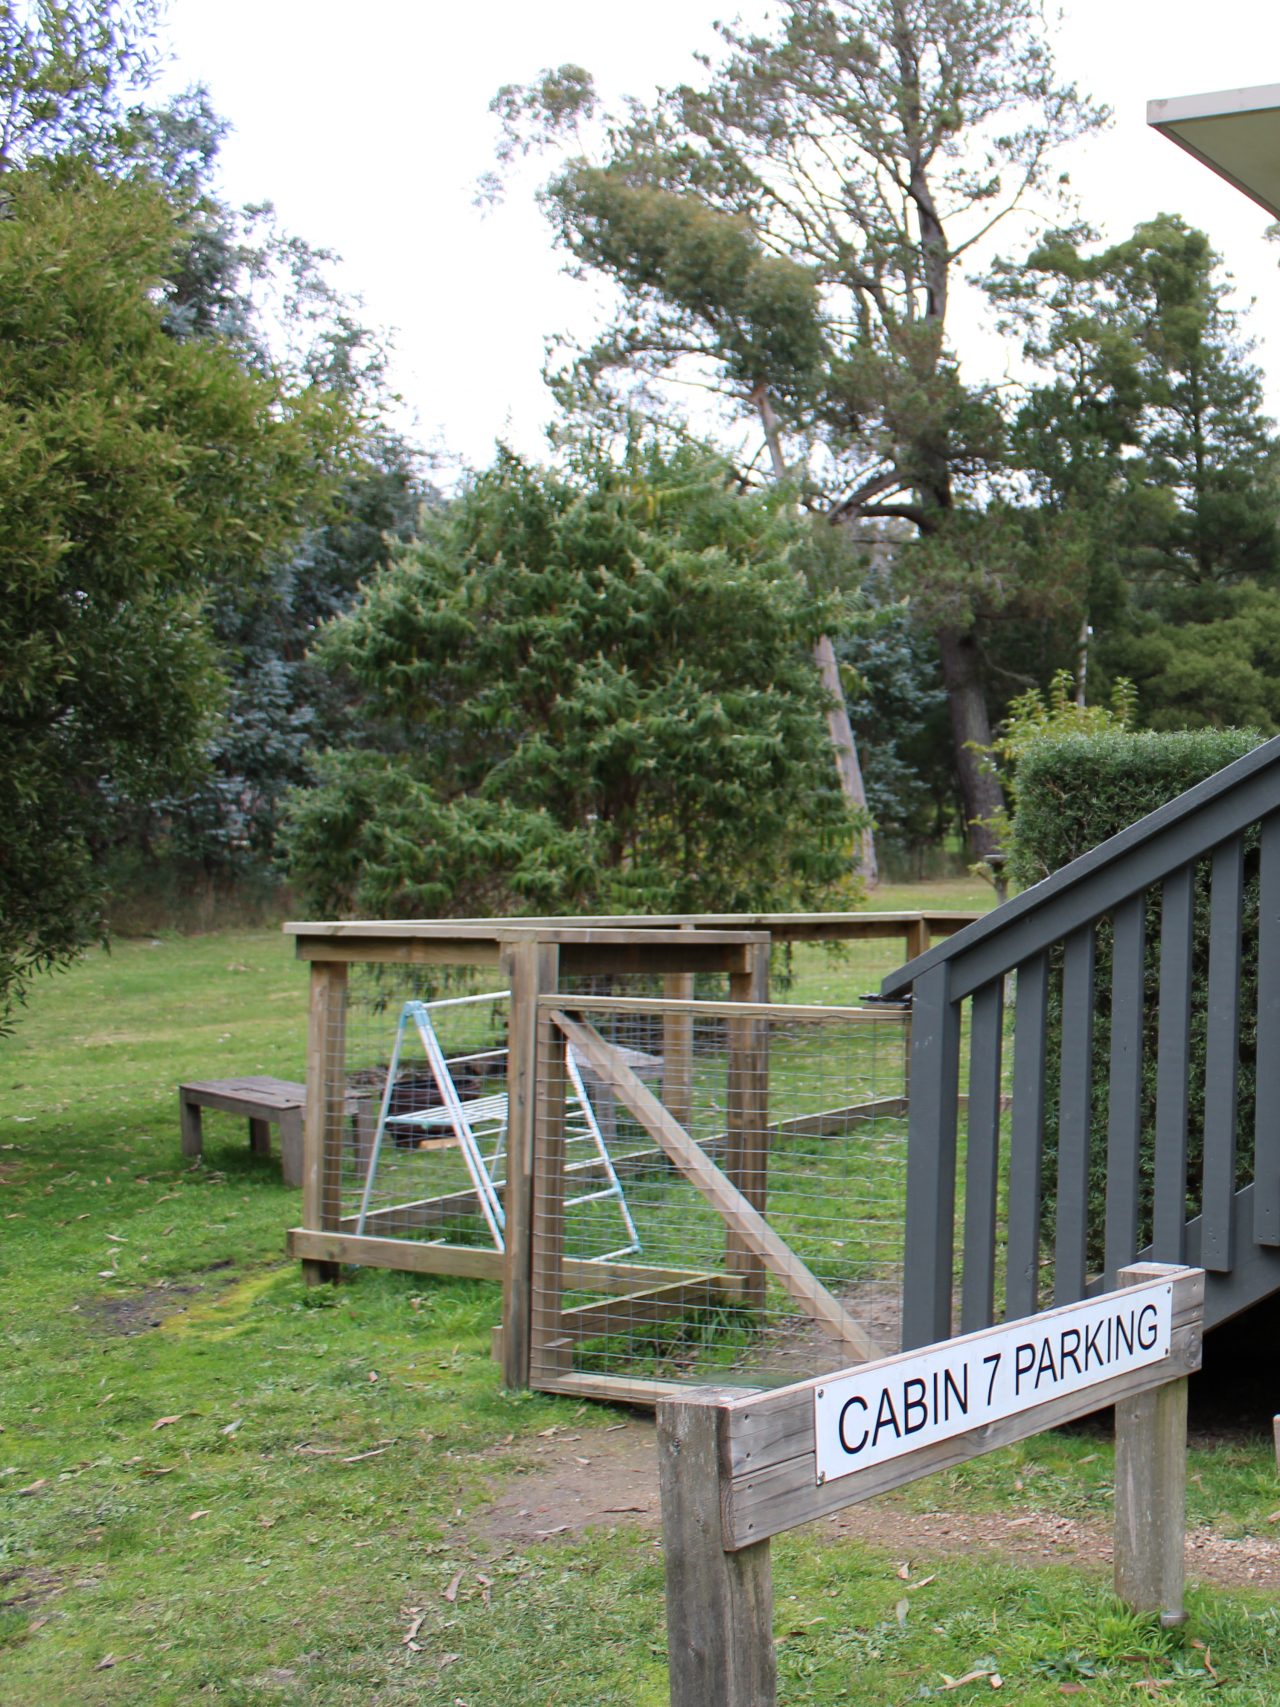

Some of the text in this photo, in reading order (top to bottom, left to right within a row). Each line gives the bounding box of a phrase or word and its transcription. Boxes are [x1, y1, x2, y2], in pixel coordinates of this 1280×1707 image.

[838, 1304, 1158, 1455] CABIN 7 PARKING
